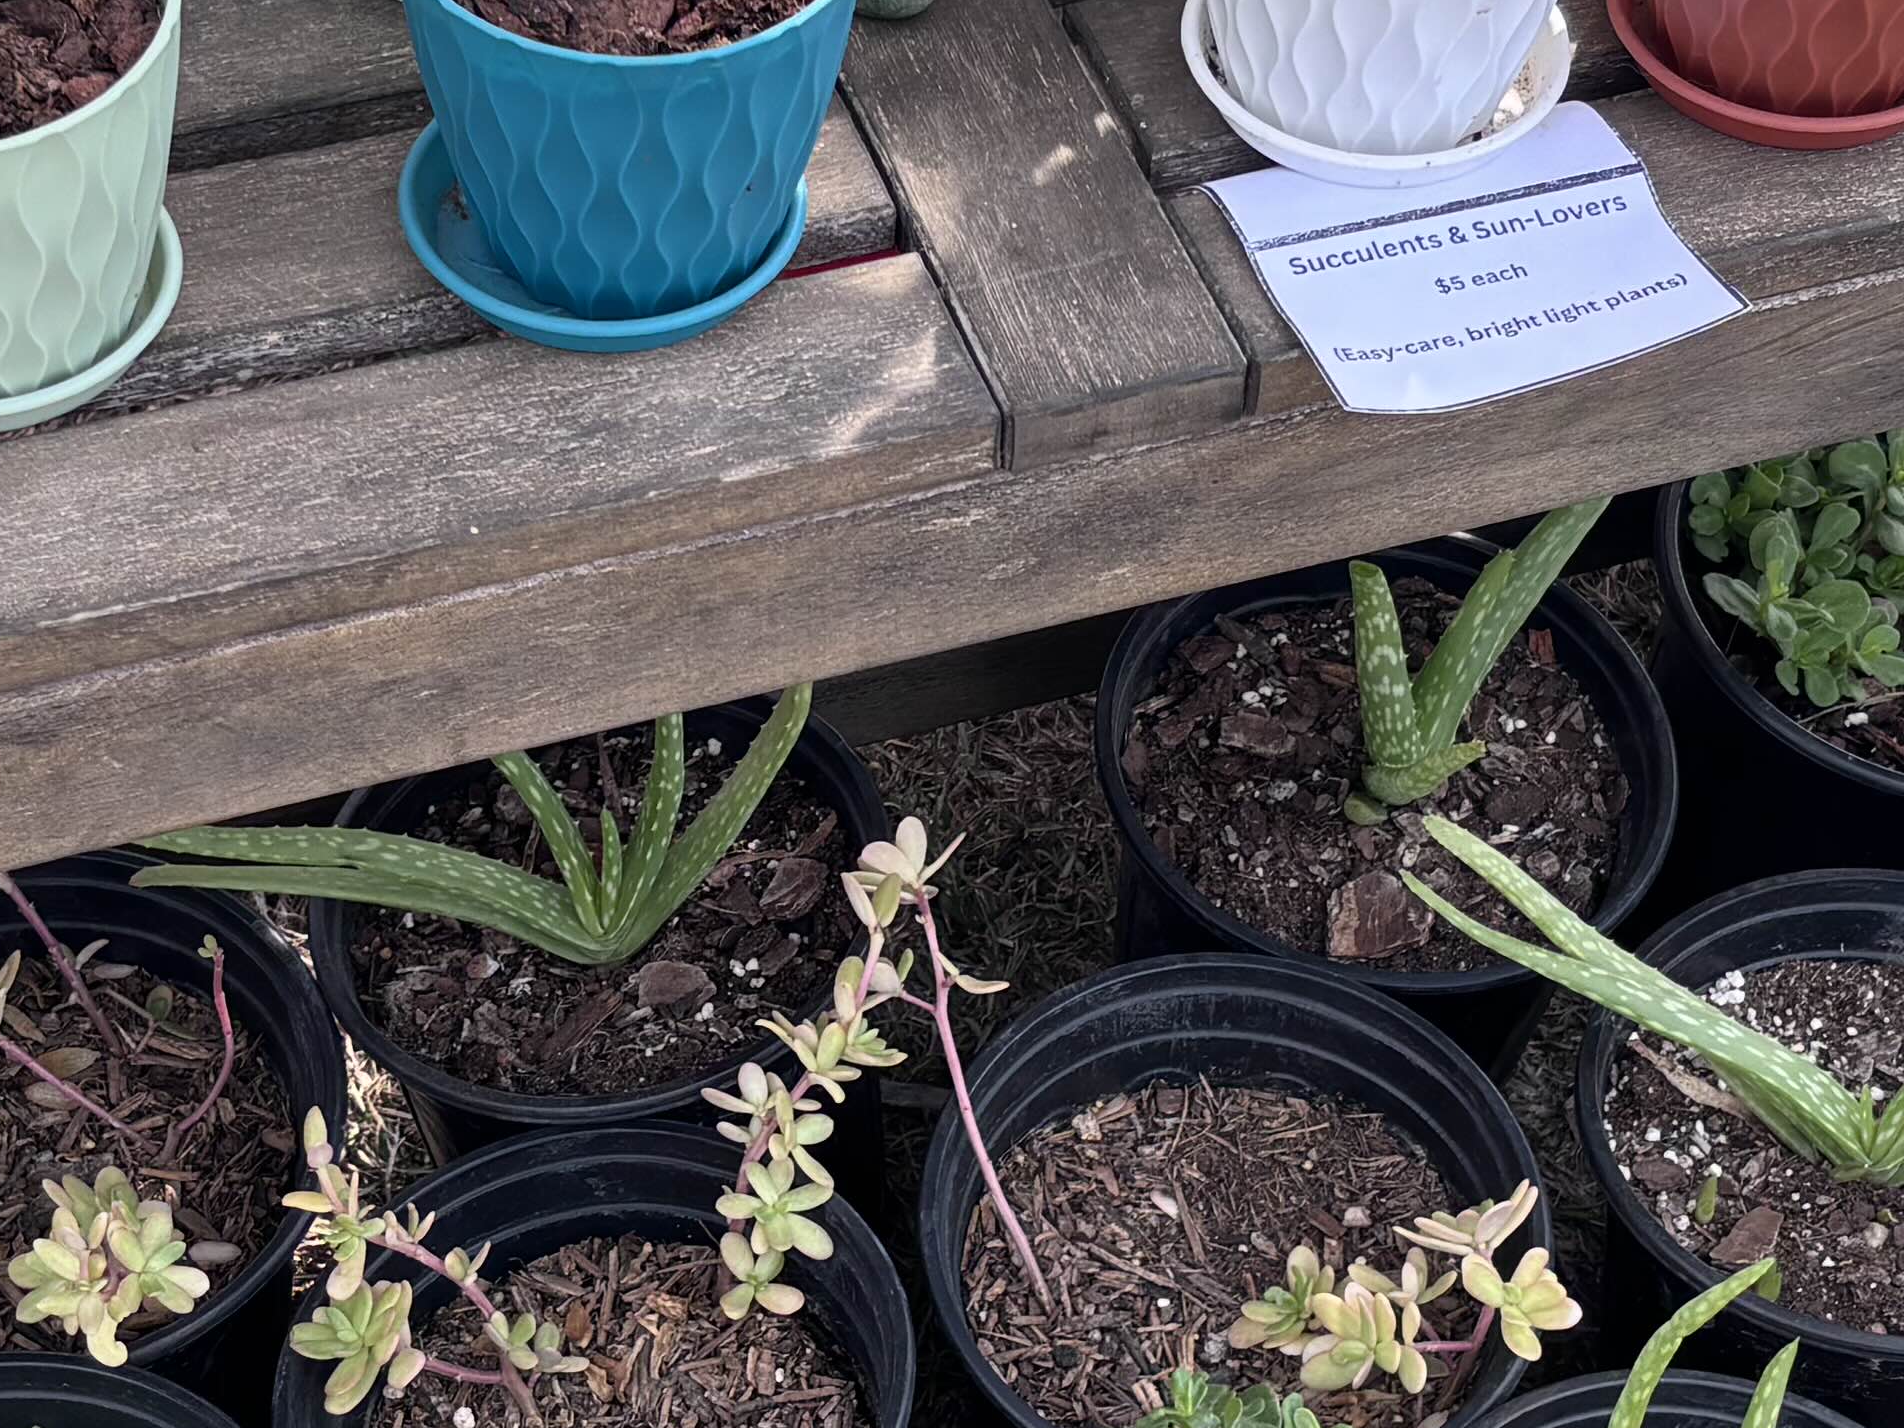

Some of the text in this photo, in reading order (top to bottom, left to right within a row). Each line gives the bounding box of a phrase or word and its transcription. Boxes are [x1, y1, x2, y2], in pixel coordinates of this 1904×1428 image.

[1289, 196, 1627, 275] Succulents & Sun-Lovers
[1333, 273, 1687, 362] (Easy-care, bright light plants)
[1435, 264, 1528, 294] $5 each
